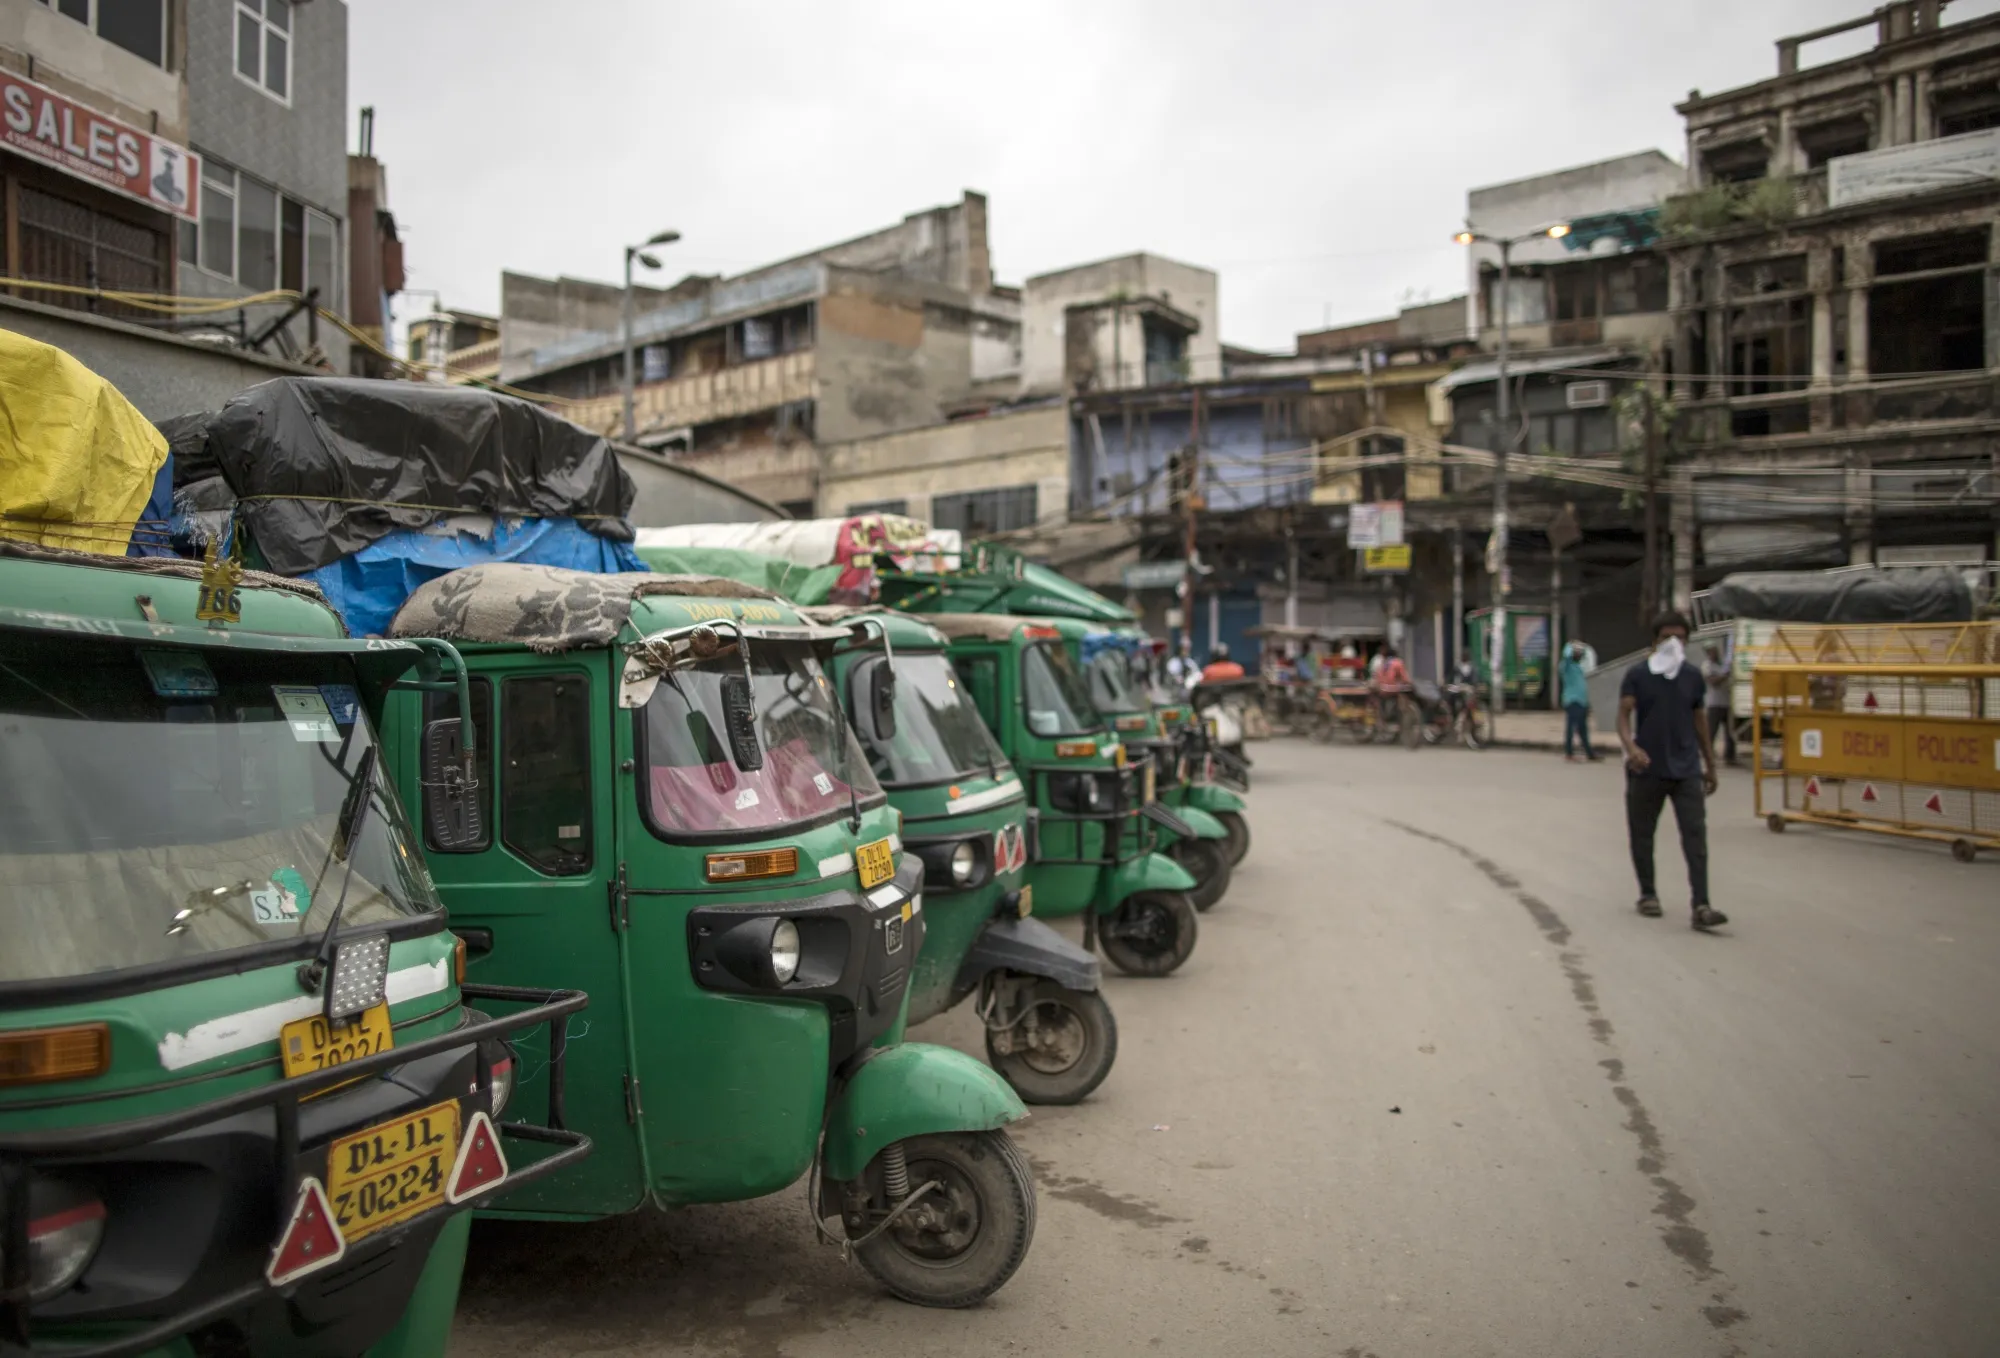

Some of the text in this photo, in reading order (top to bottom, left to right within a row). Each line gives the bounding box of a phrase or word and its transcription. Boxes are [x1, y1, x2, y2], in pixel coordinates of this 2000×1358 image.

[4, 84, 141, 178] SALES
[199, 585, 242, 614] 786
[1842, 730, 1980, 765] DELHI POLICE
